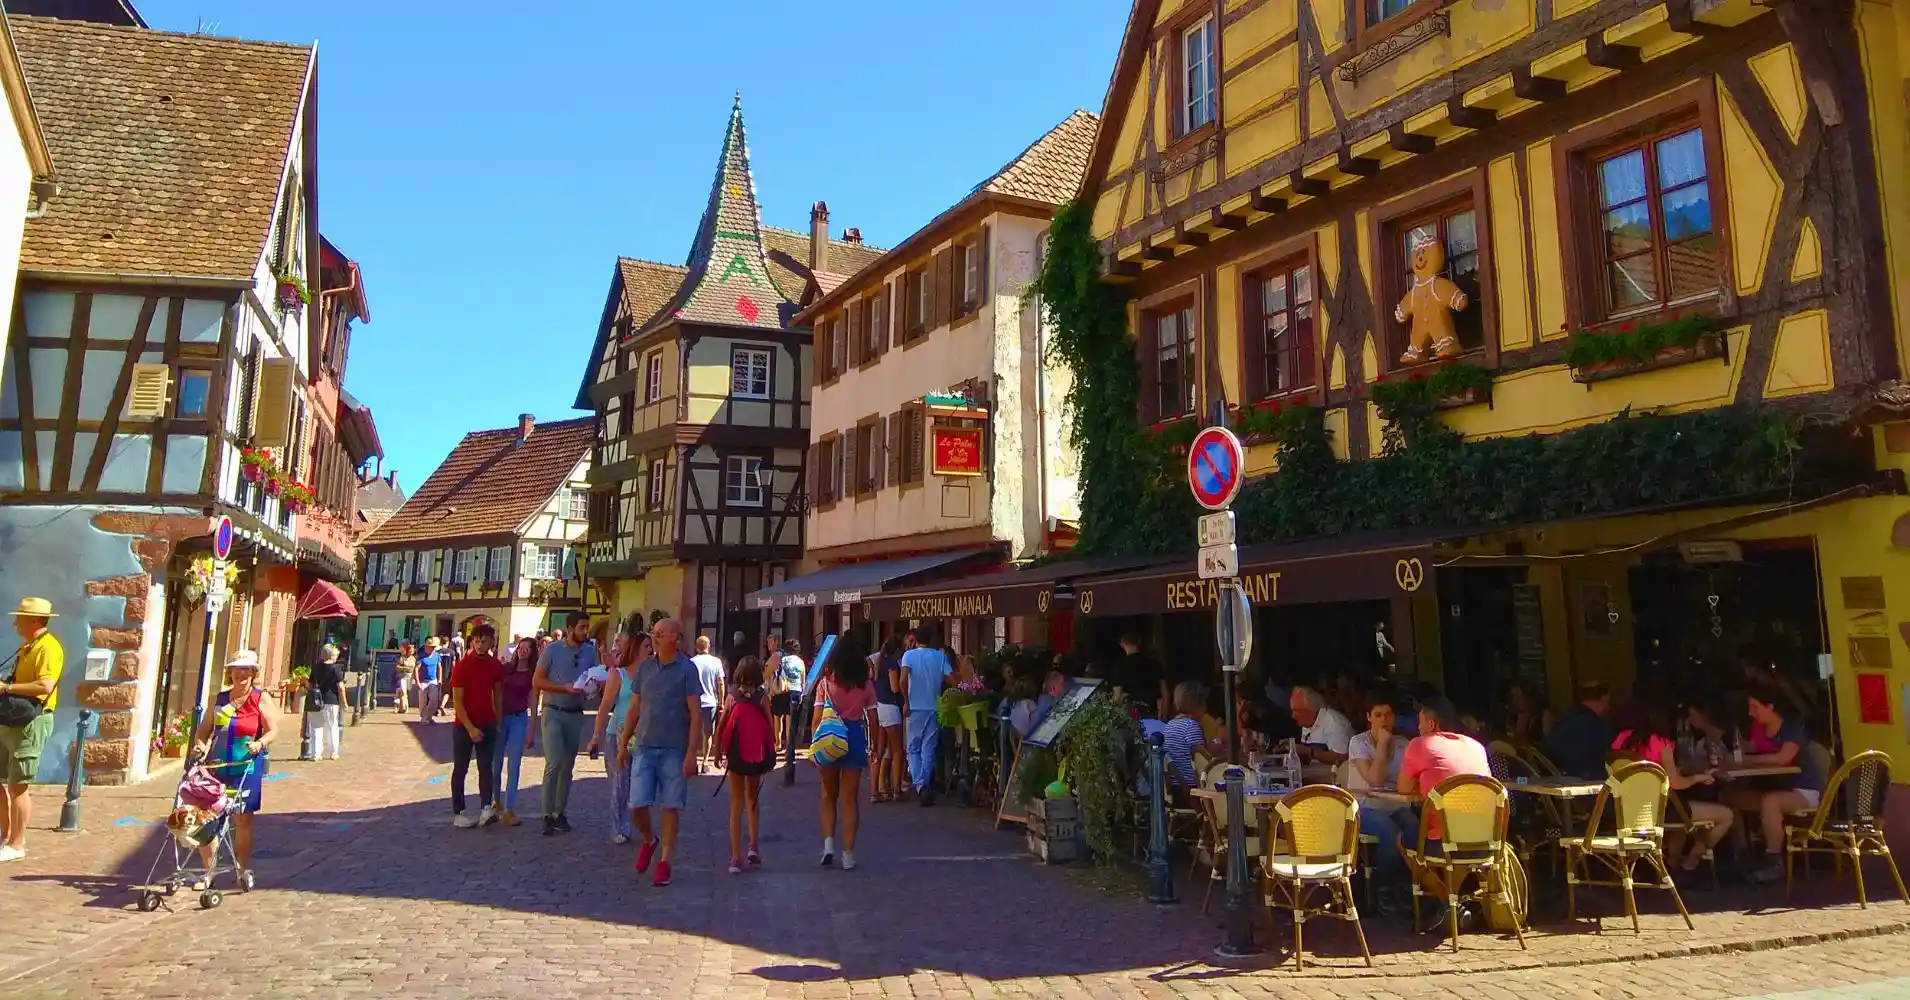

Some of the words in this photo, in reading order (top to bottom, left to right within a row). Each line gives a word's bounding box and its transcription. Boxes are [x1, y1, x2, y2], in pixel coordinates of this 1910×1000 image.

[1167, 572, 1281, 609] RESTAANT
[900, 598, 951, 618] BRATSCHALL
[954, 594, 993, 617] MANALA
